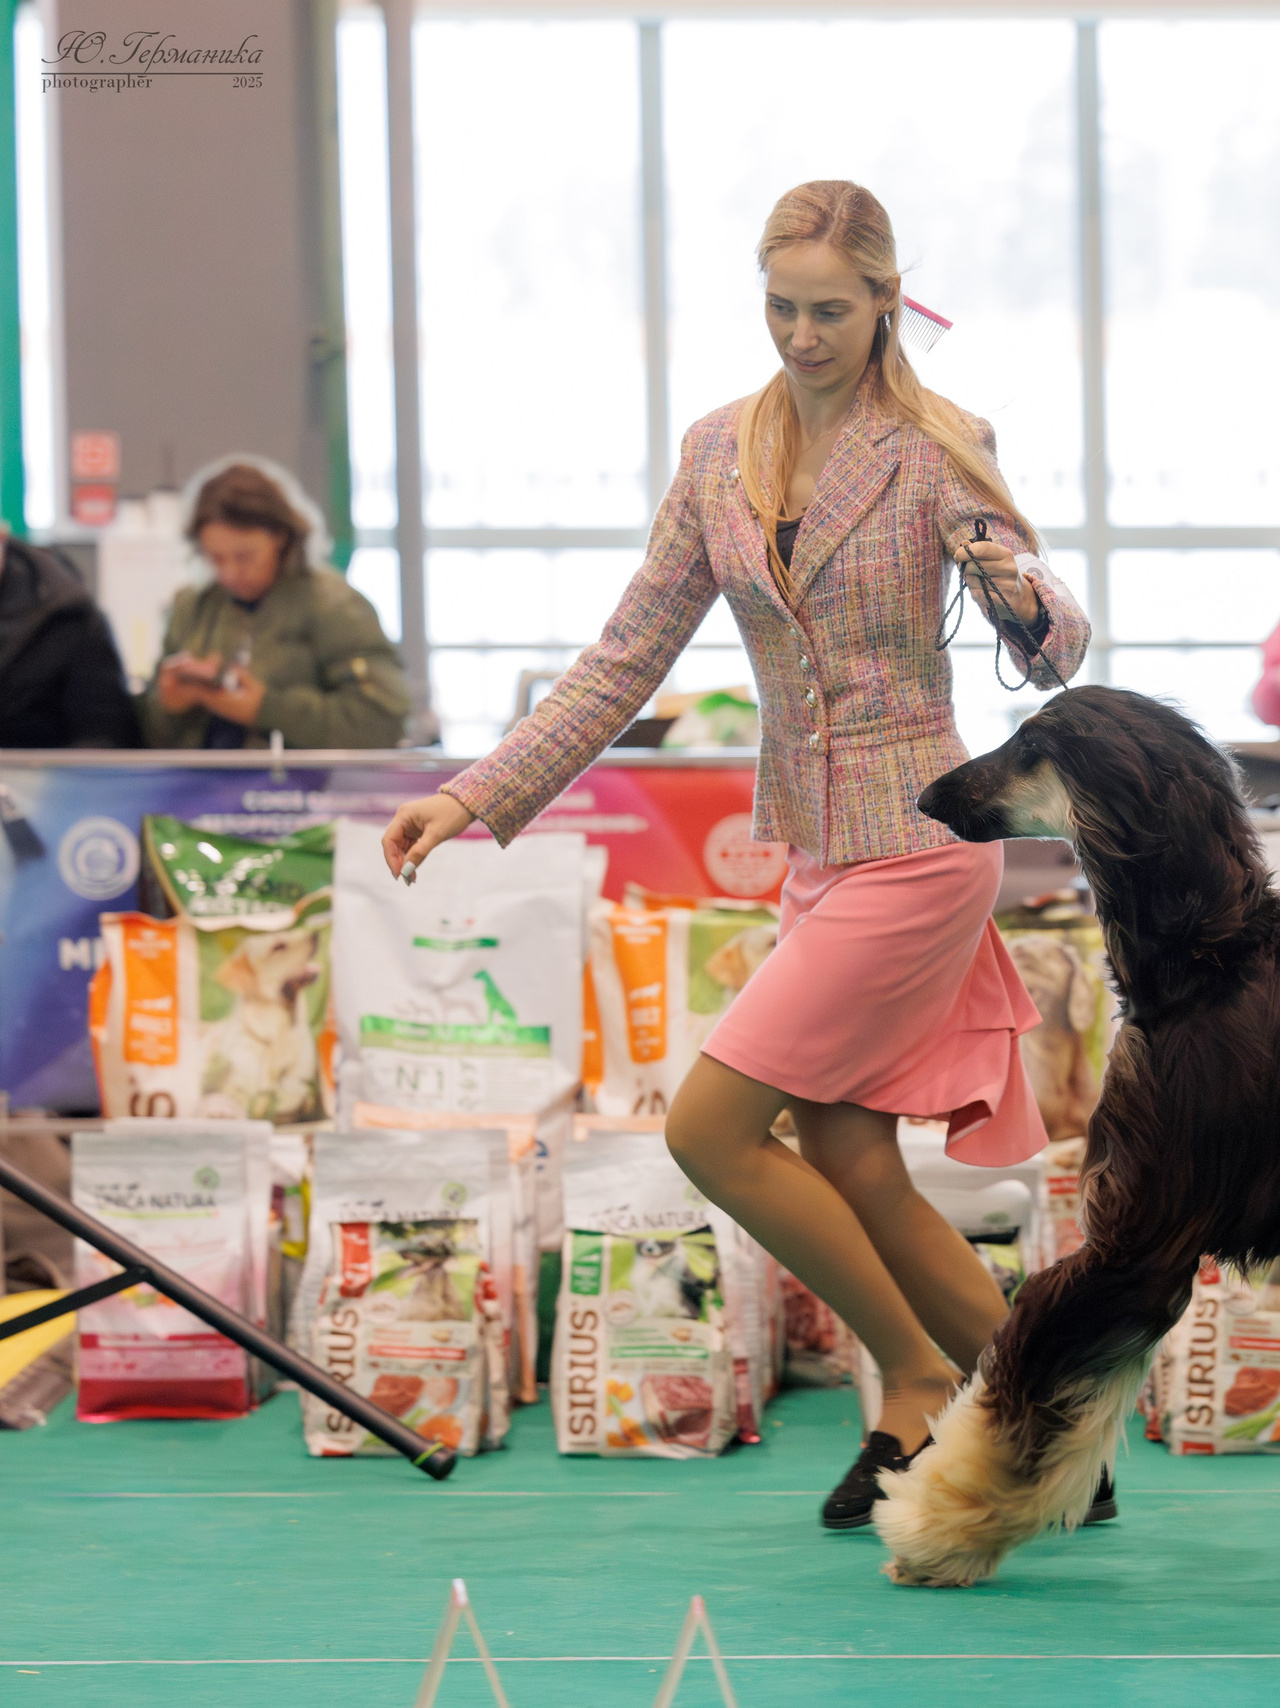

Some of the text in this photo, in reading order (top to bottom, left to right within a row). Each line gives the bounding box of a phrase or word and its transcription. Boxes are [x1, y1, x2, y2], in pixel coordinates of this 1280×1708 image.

[326, 1308, 359, 1434] SRIUS
[568, 1308, 599, 1436] SIRIUS
[1185, 1298, 1219, 1427] SIRIUS
